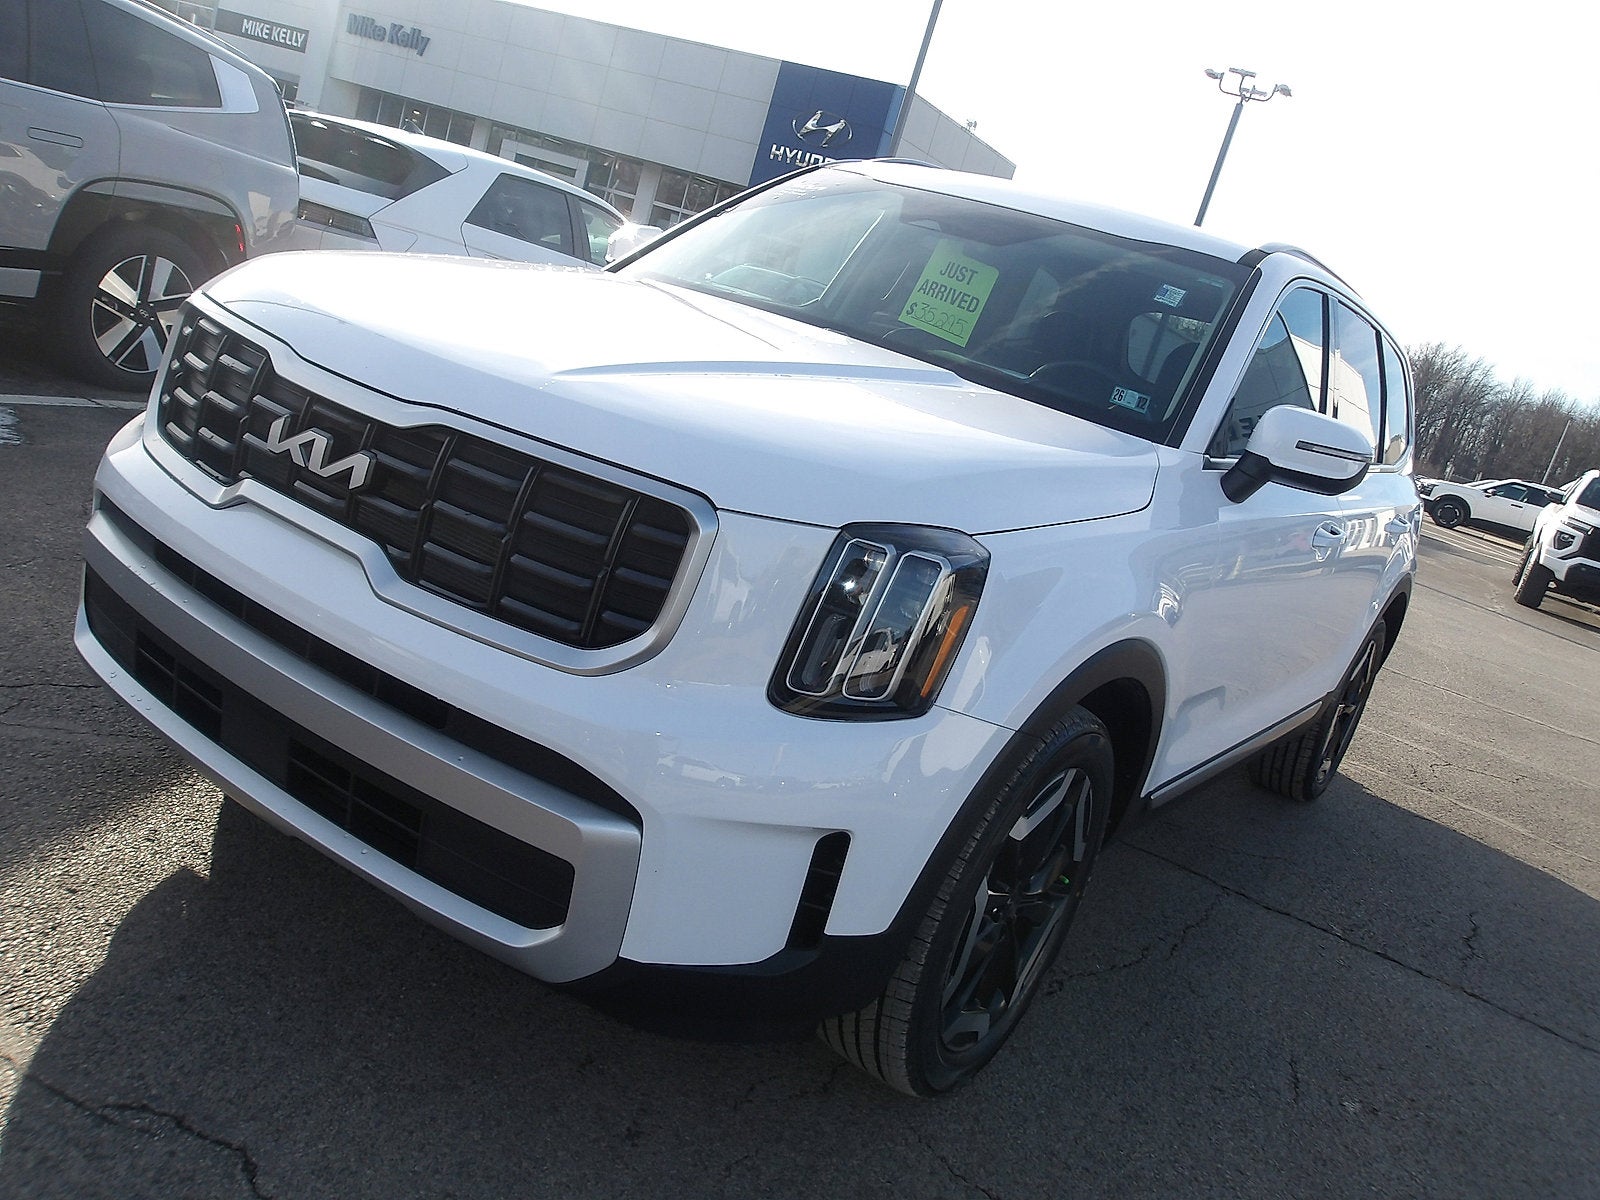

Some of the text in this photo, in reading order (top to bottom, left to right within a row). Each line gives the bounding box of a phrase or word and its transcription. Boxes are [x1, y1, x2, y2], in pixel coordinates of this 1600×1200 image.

[241, 18, 304, 48] MIKE KELLY
[347, 13, 430, 57] Mike Kelly
[940, 261, 978, 285] JUST
[917, 279, 980, 313] ARRIVED
[1113, 388, 1125, 402] 26
[266, 414, 374, 490] KIA
